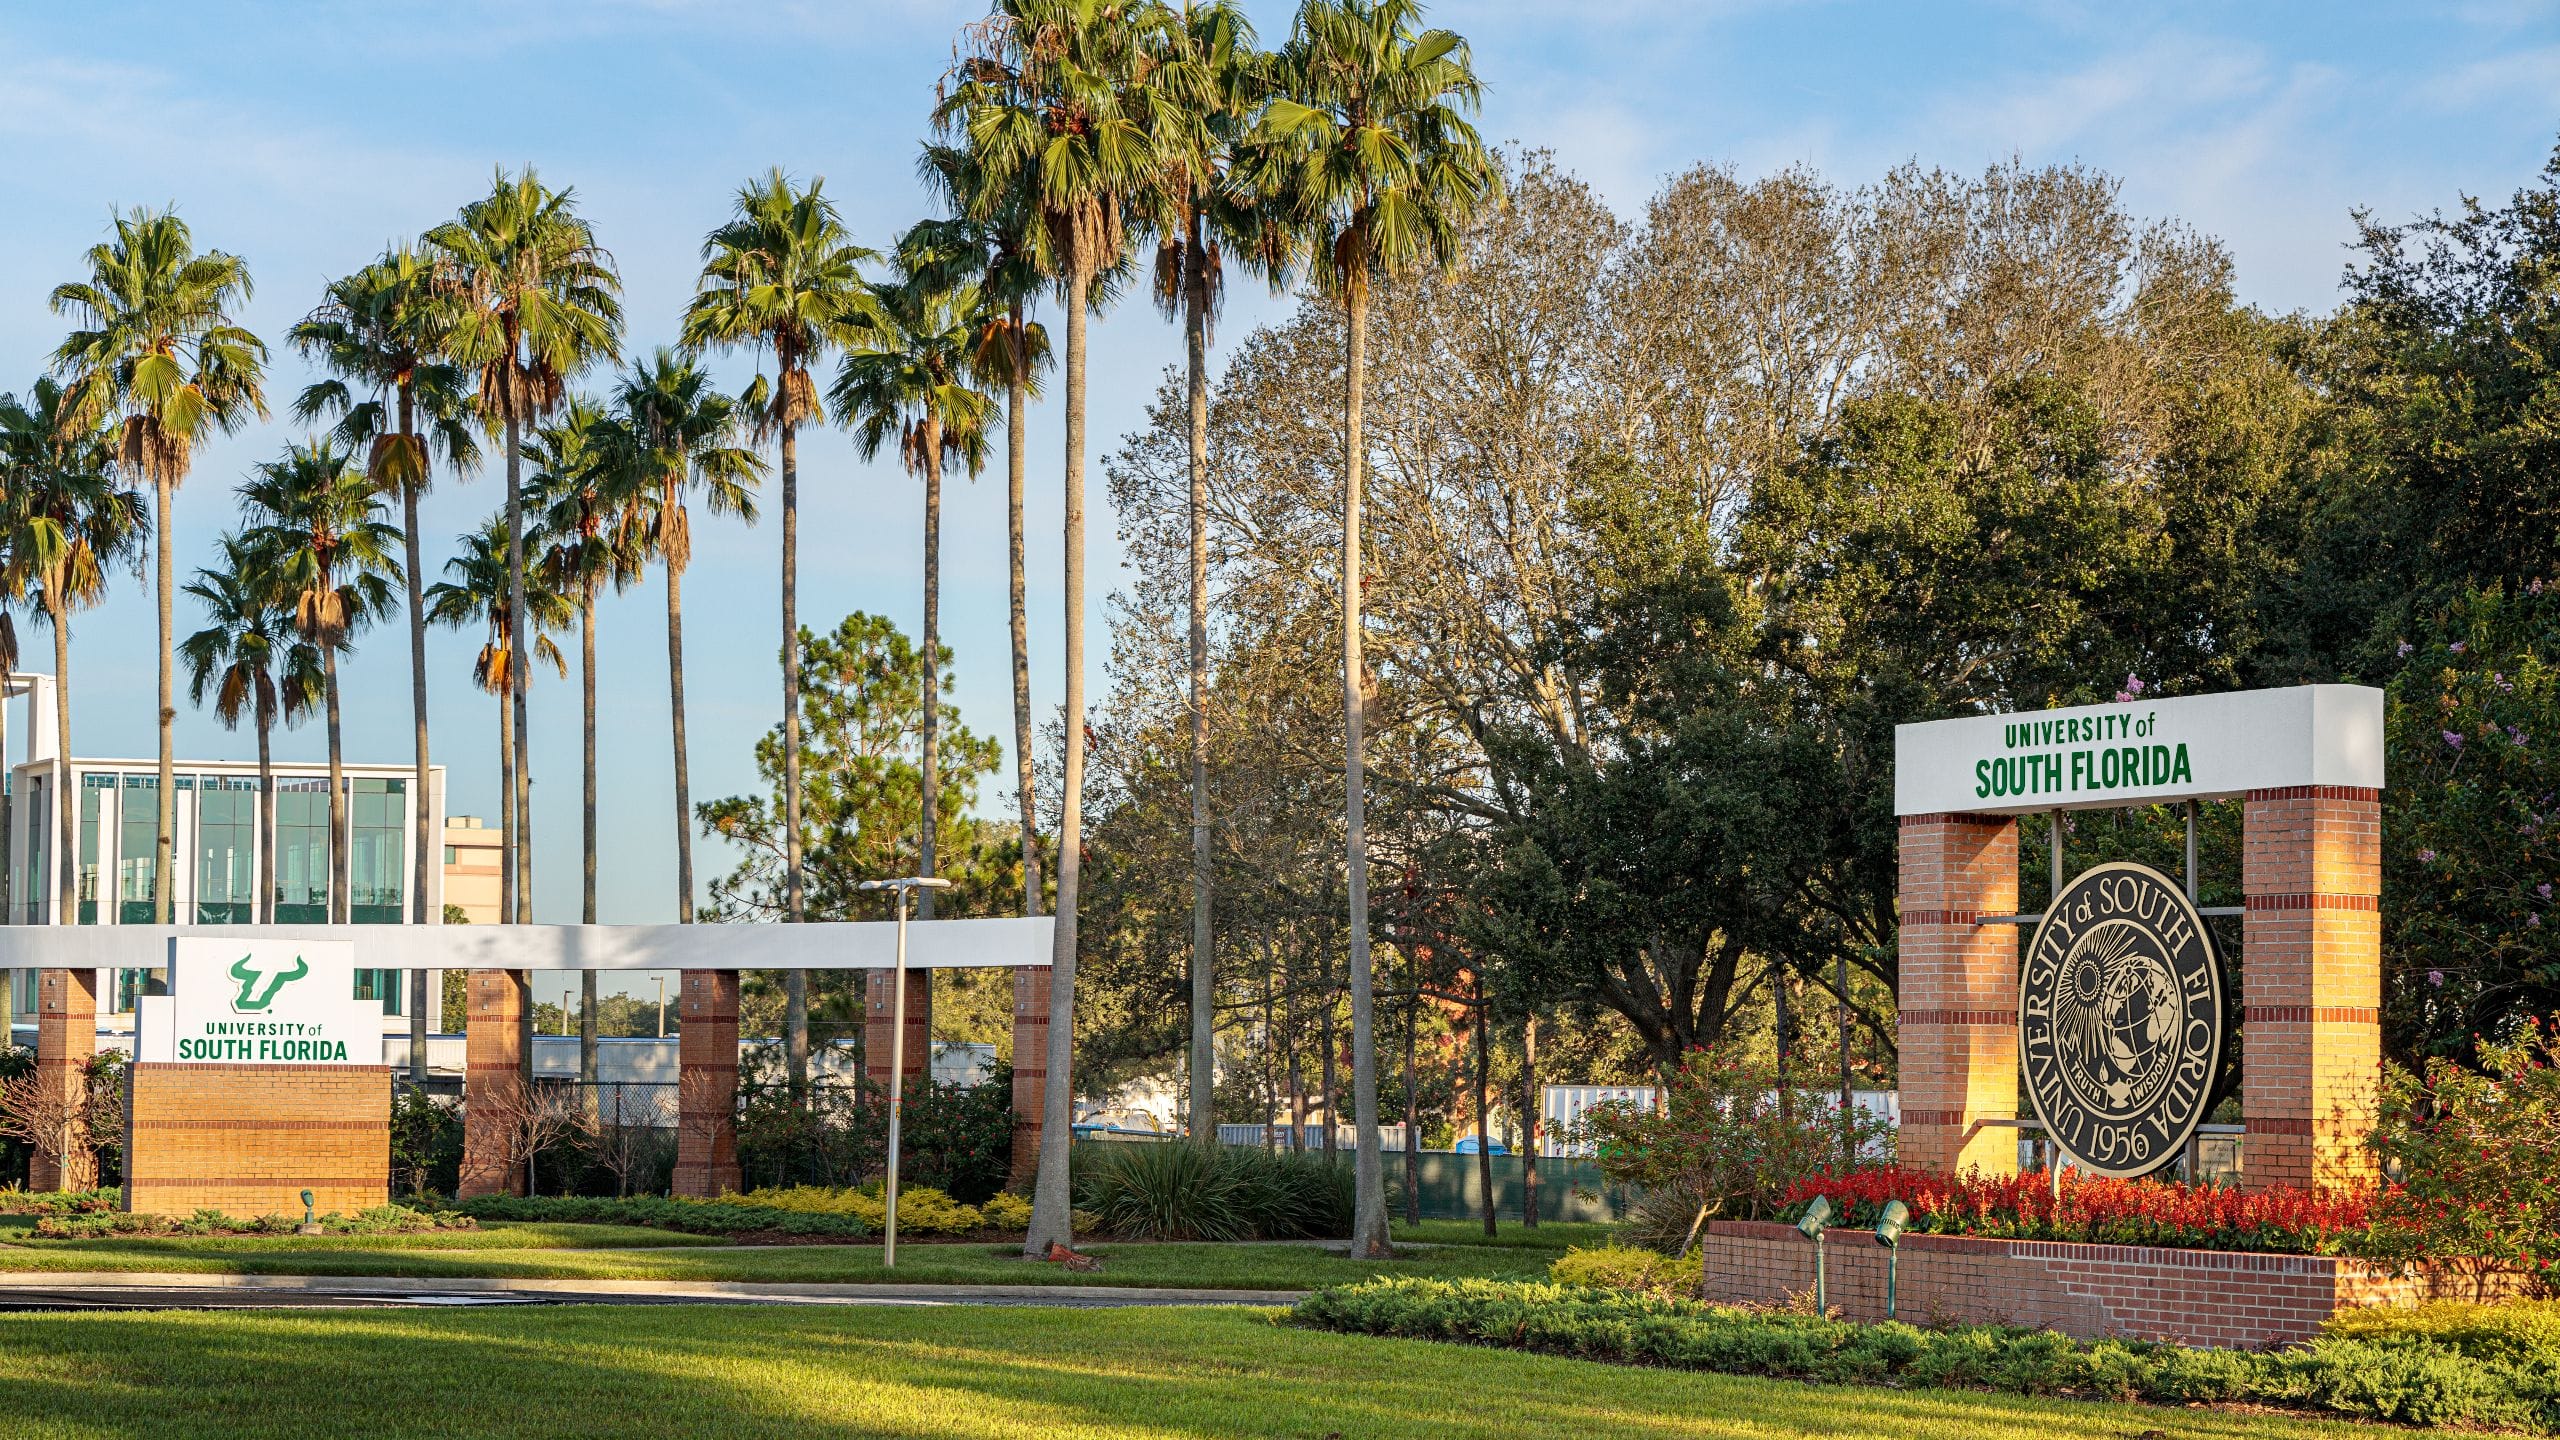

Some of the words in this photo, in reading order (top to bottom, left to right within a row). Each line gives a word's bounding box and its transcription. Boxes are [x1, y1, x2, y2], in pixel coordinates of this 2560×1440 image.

[2005, 712, 2131, 749] UNIVERSITY
[2135, 711, 2157, 739] of
[1975, 752, 2063, 799] SOUTH
[2071, 742, 2193, 791] FLORIDA
[2075, 890, 2094, 924] of
[2100, 876, 2195, 960] SOUTH
[206, 1022, 305, 1036] UNIVERSITY
[308, 1023, 322, 1037] of
[2027, 902, 2085, 1147] UNIVERSITY
[179, 1038, 251, 1060] SOUTH
[259, 1039, 348, 1061] FLORIDA
[2146, 962, 2211, 1142] FLORIDA
[2071, 1061, 2101, 1103] TRUTH
[2132, 1051, 2170, 1101] WISDOM
[2087, 1121, 2150, 1165] 1956
